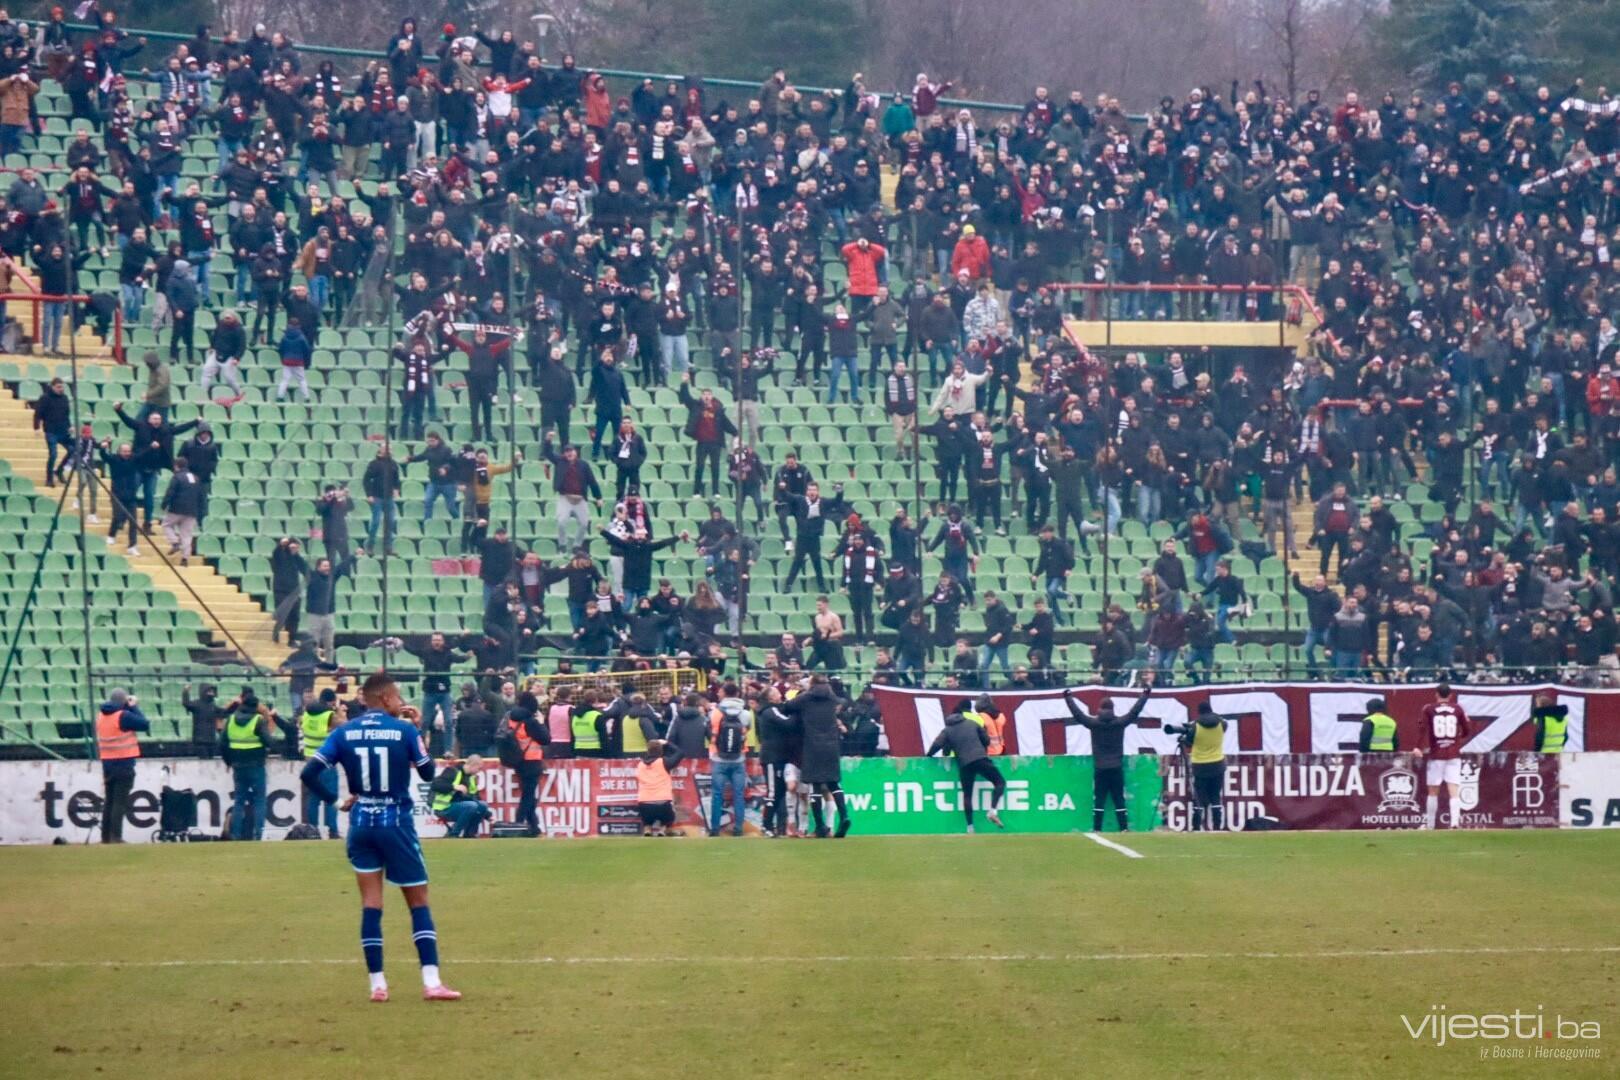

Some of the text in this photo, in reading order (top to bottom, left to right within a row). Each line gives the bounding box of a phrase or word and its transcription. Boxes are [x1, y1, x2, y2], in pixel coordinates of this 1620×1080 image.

[364, 729, 402, 741] PEIXOTO
[354, 746, 389, 792] 11
[1168, 757, 1366, 797] HELI ILIDŽA
[1440, 812, 1495, 824] CYSTAL
